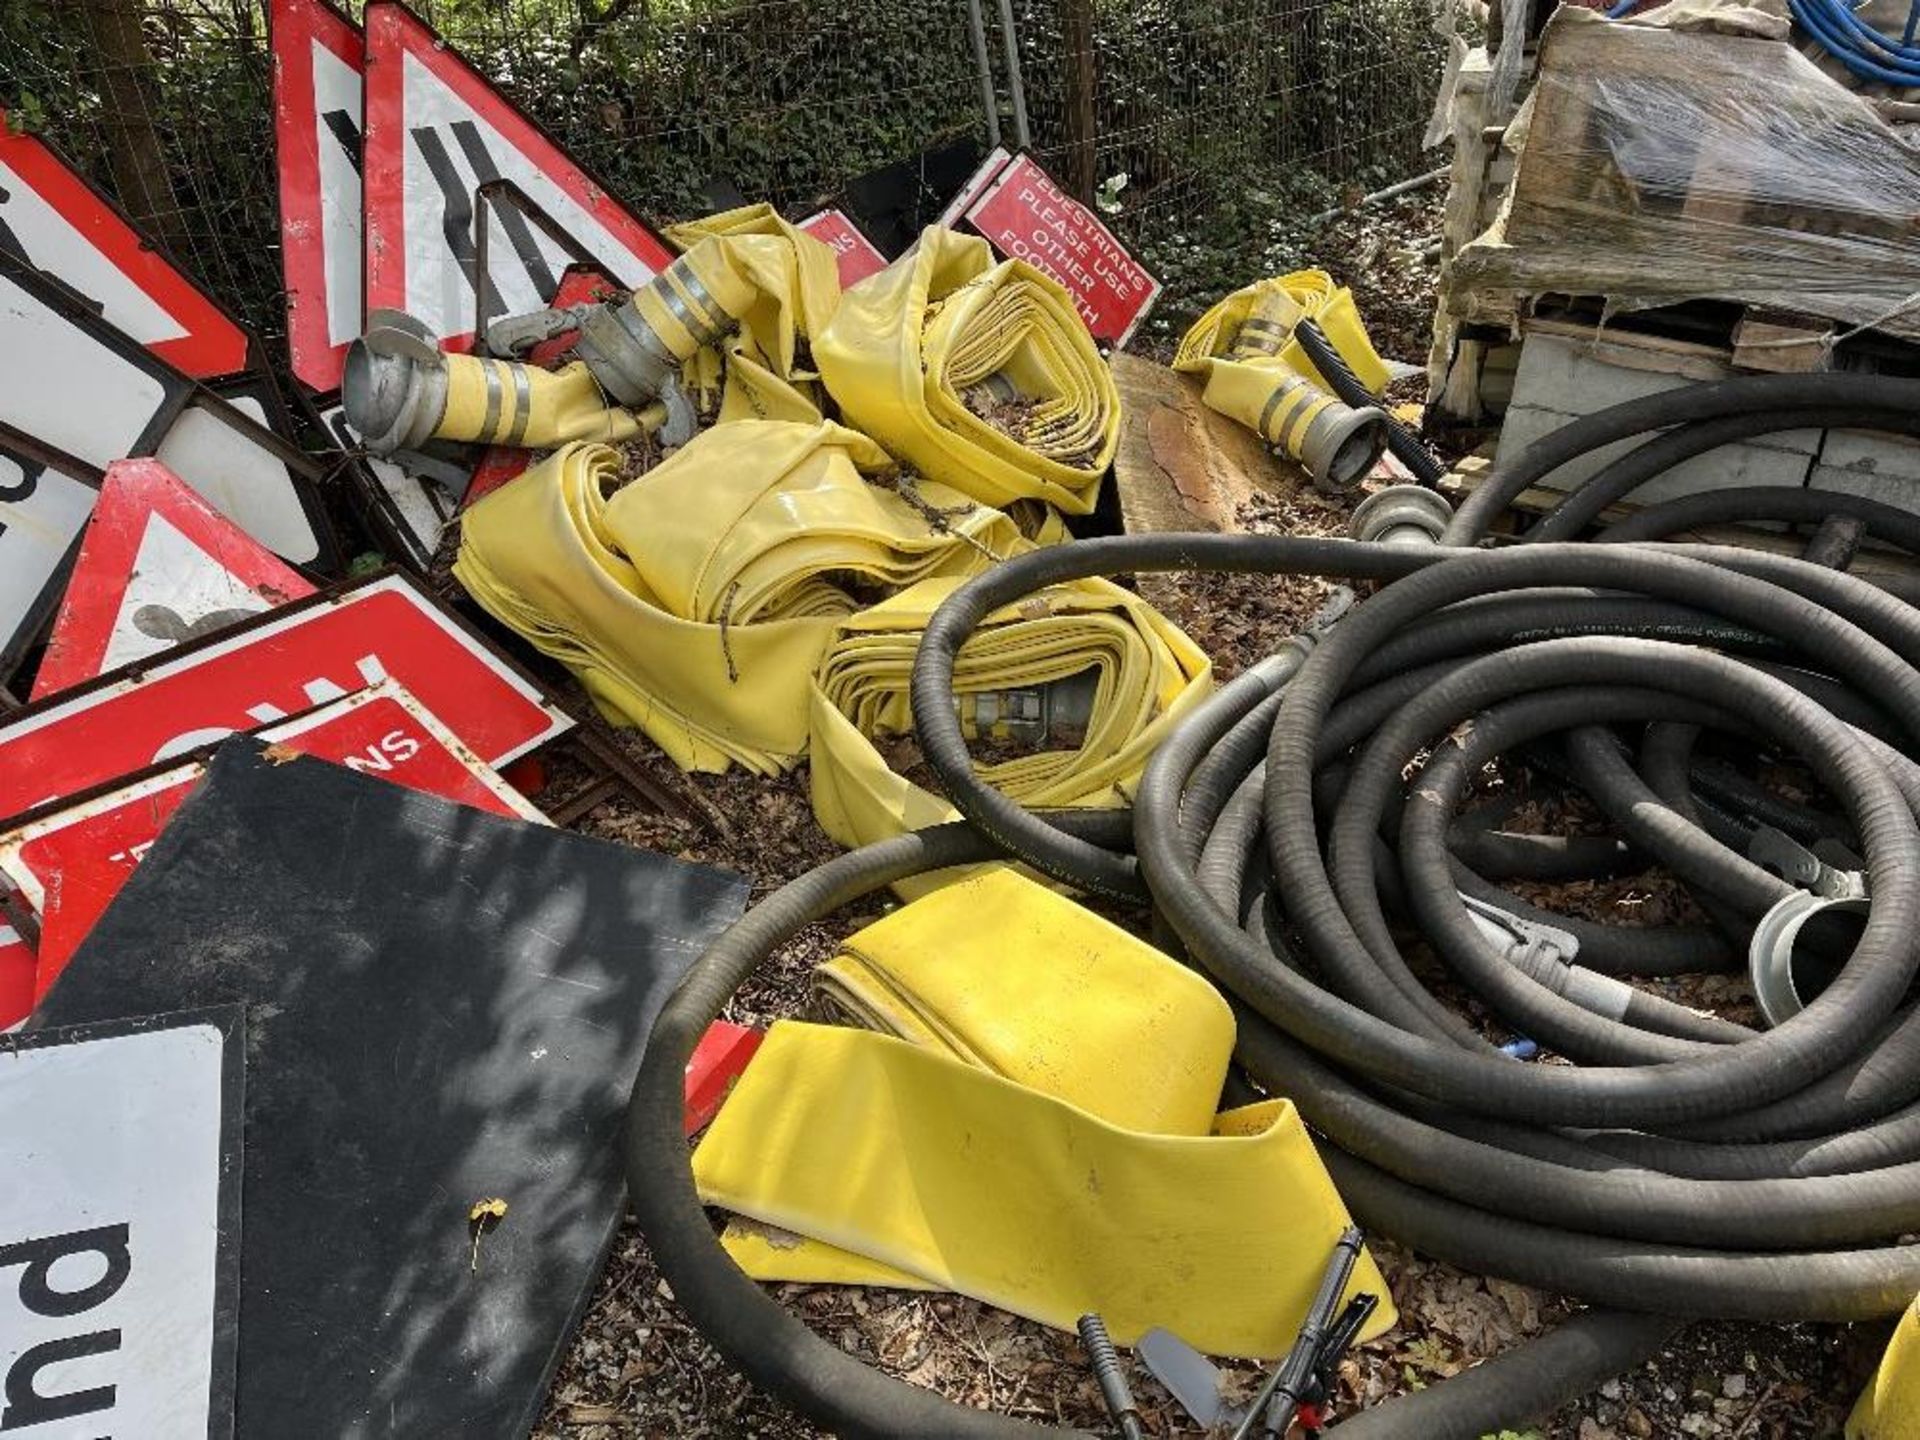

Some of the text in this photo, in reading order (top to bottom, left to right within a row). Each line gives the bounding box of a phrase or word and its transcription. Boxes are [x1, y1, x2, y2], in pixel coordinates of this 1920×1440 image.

[1018, 188, 1130, 300] PLEASE USE
[1032, 229, 1096, 293] OTHER
[0, 1223, 131, 1440] nd
